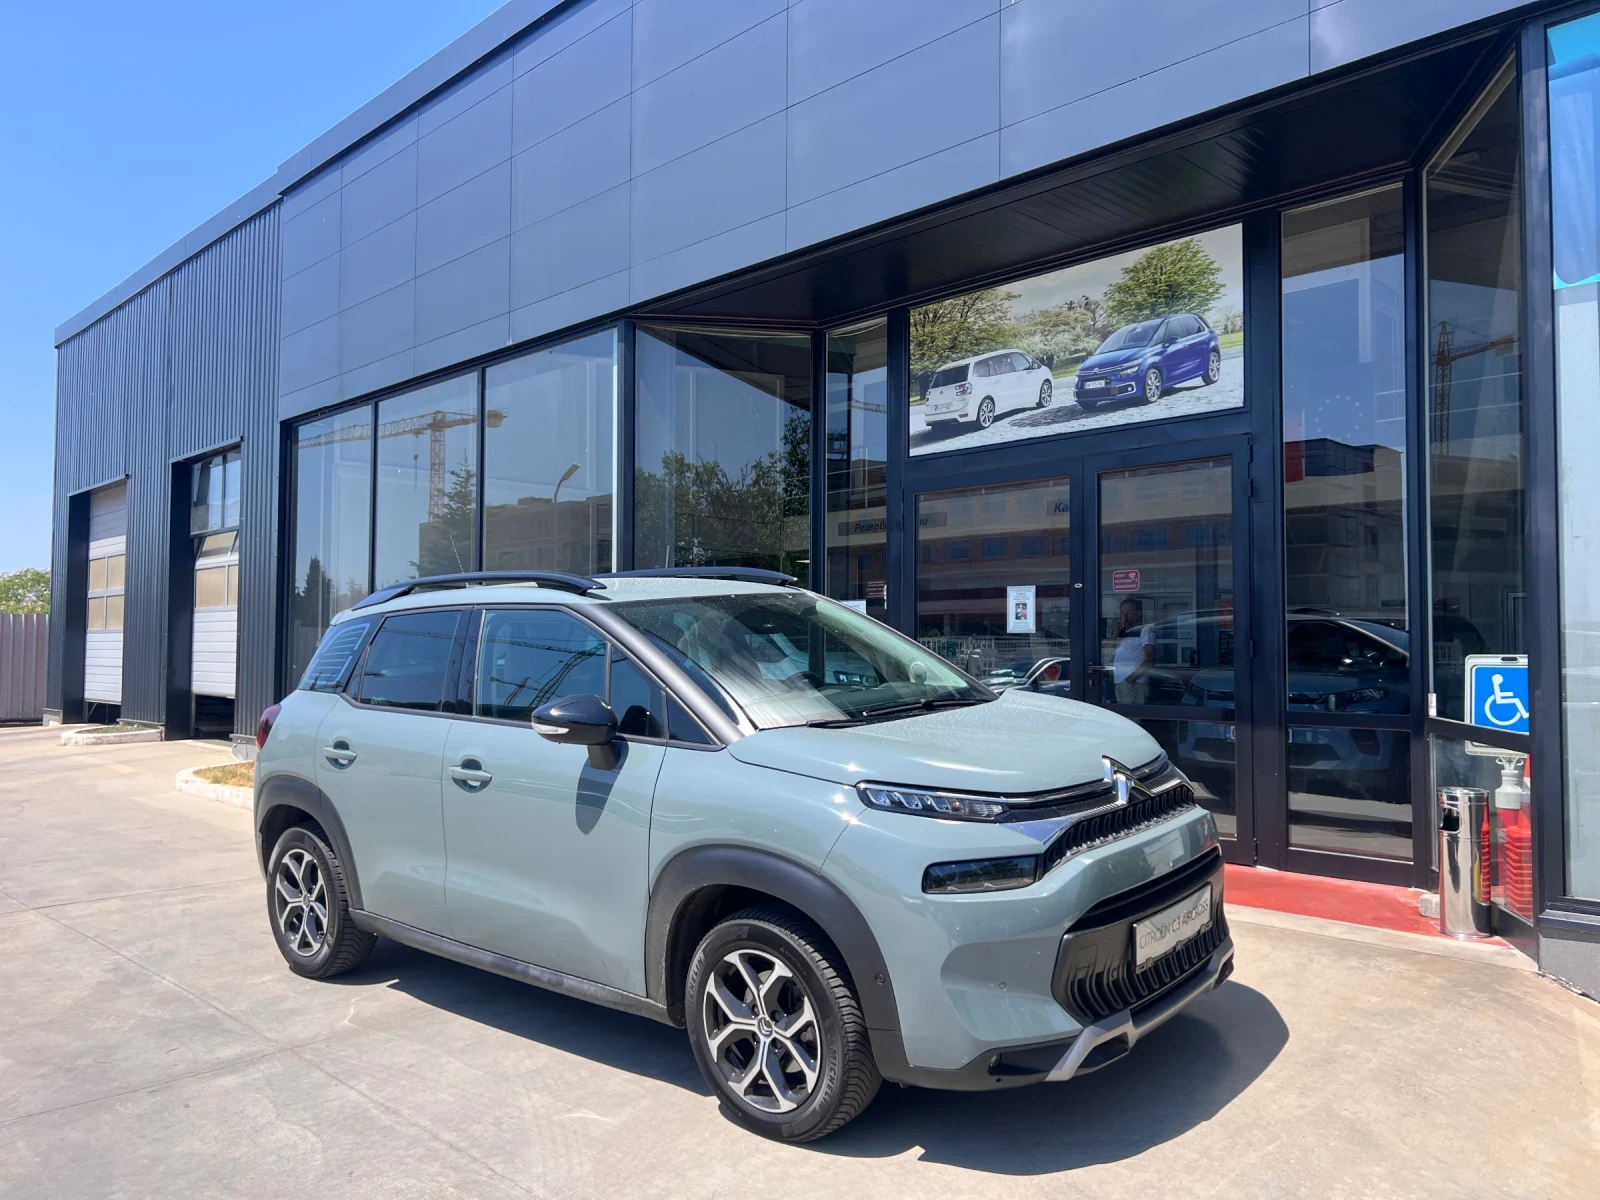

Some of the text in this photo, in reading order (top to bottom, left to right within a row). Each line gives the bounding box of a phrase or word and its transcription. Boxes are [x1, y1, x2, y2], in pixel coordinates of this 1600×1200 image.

[854, 520, 887, 533] Резерв
[1140, 899, 1209, 949] CITROËN C3 AIRCROSS
[815, 1047, 838, 1110] MICHELIN
